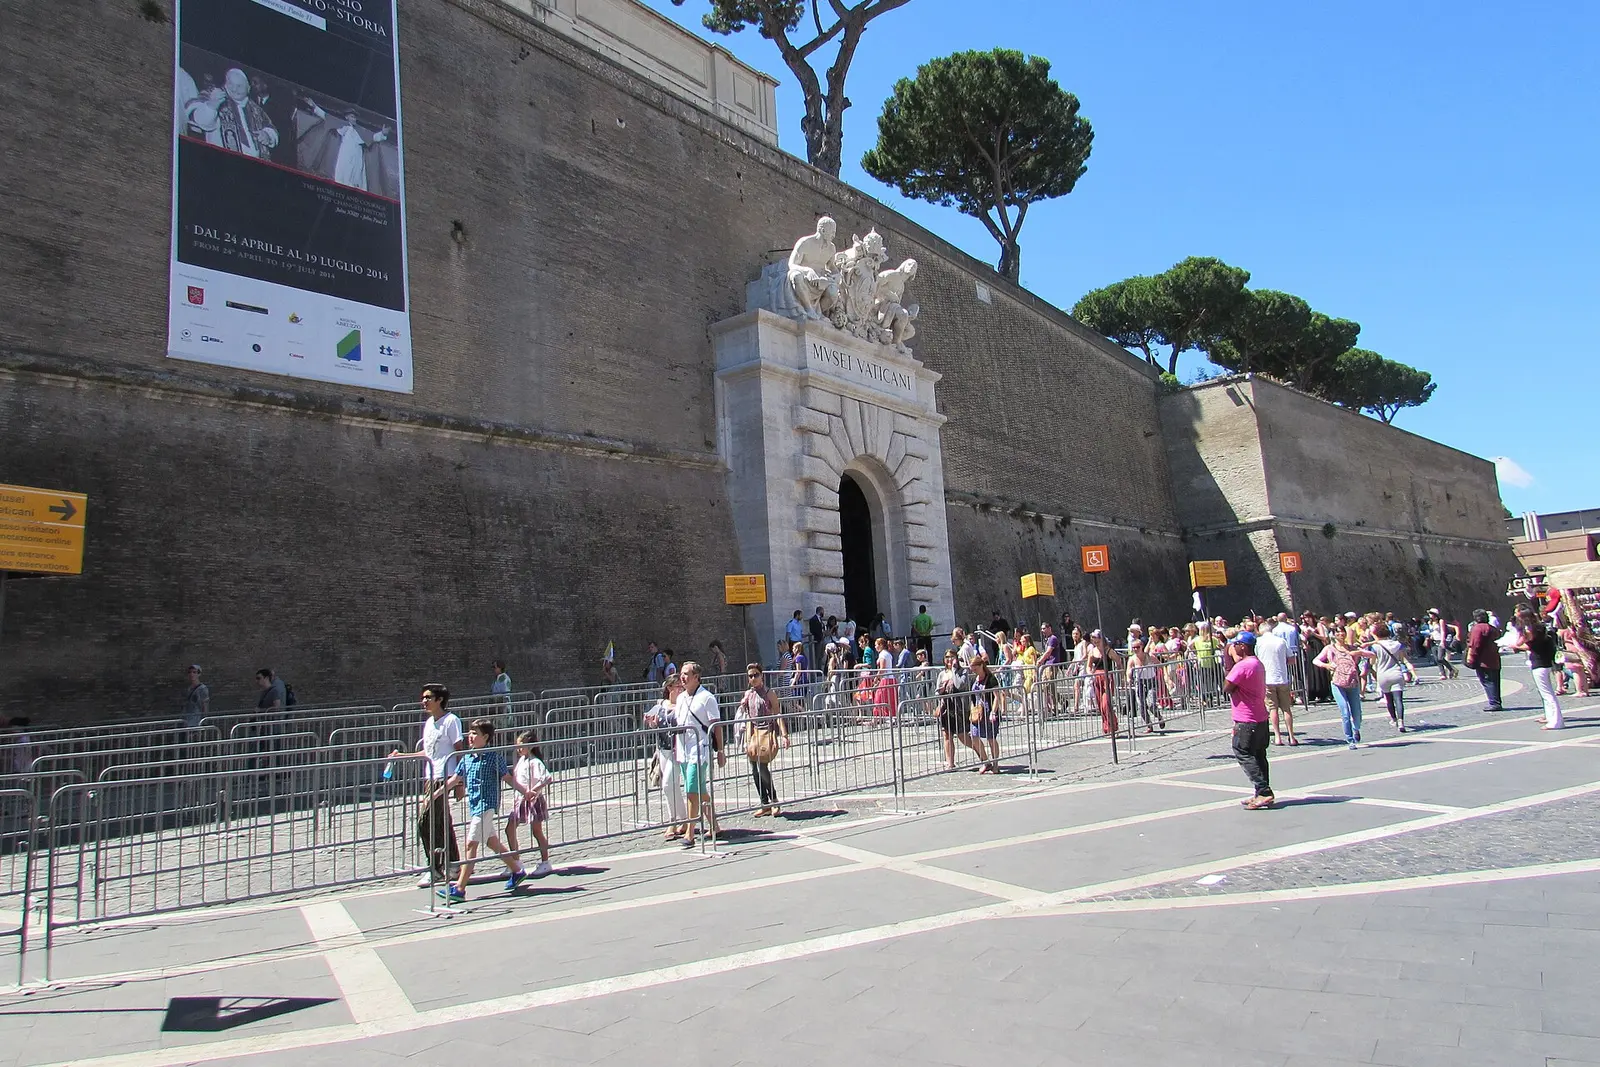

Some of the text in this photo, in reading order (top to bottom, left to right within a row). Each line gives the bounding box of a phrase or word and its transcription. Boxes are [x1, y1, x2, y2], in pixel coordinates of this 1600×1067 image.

[336, 8, 387, 37] STORIA
[193, 240, 220, 252] FROM
[238, 251, 263, 263] APRIL
[265, 257, 278, 266] TO
[297, 265, 317, 276] JULY
[319, 270, 336, 279] 2014
[194, 224, 389, 281] DAL 24 APRILE AL 19 LUGLIO 2014
[813, 343, 911, 391] MVSEI VATICANI
[18, 551, 56, 560] entrance
[45, 537, 72, 546] online
[16, 560, 70, 571] reservations
